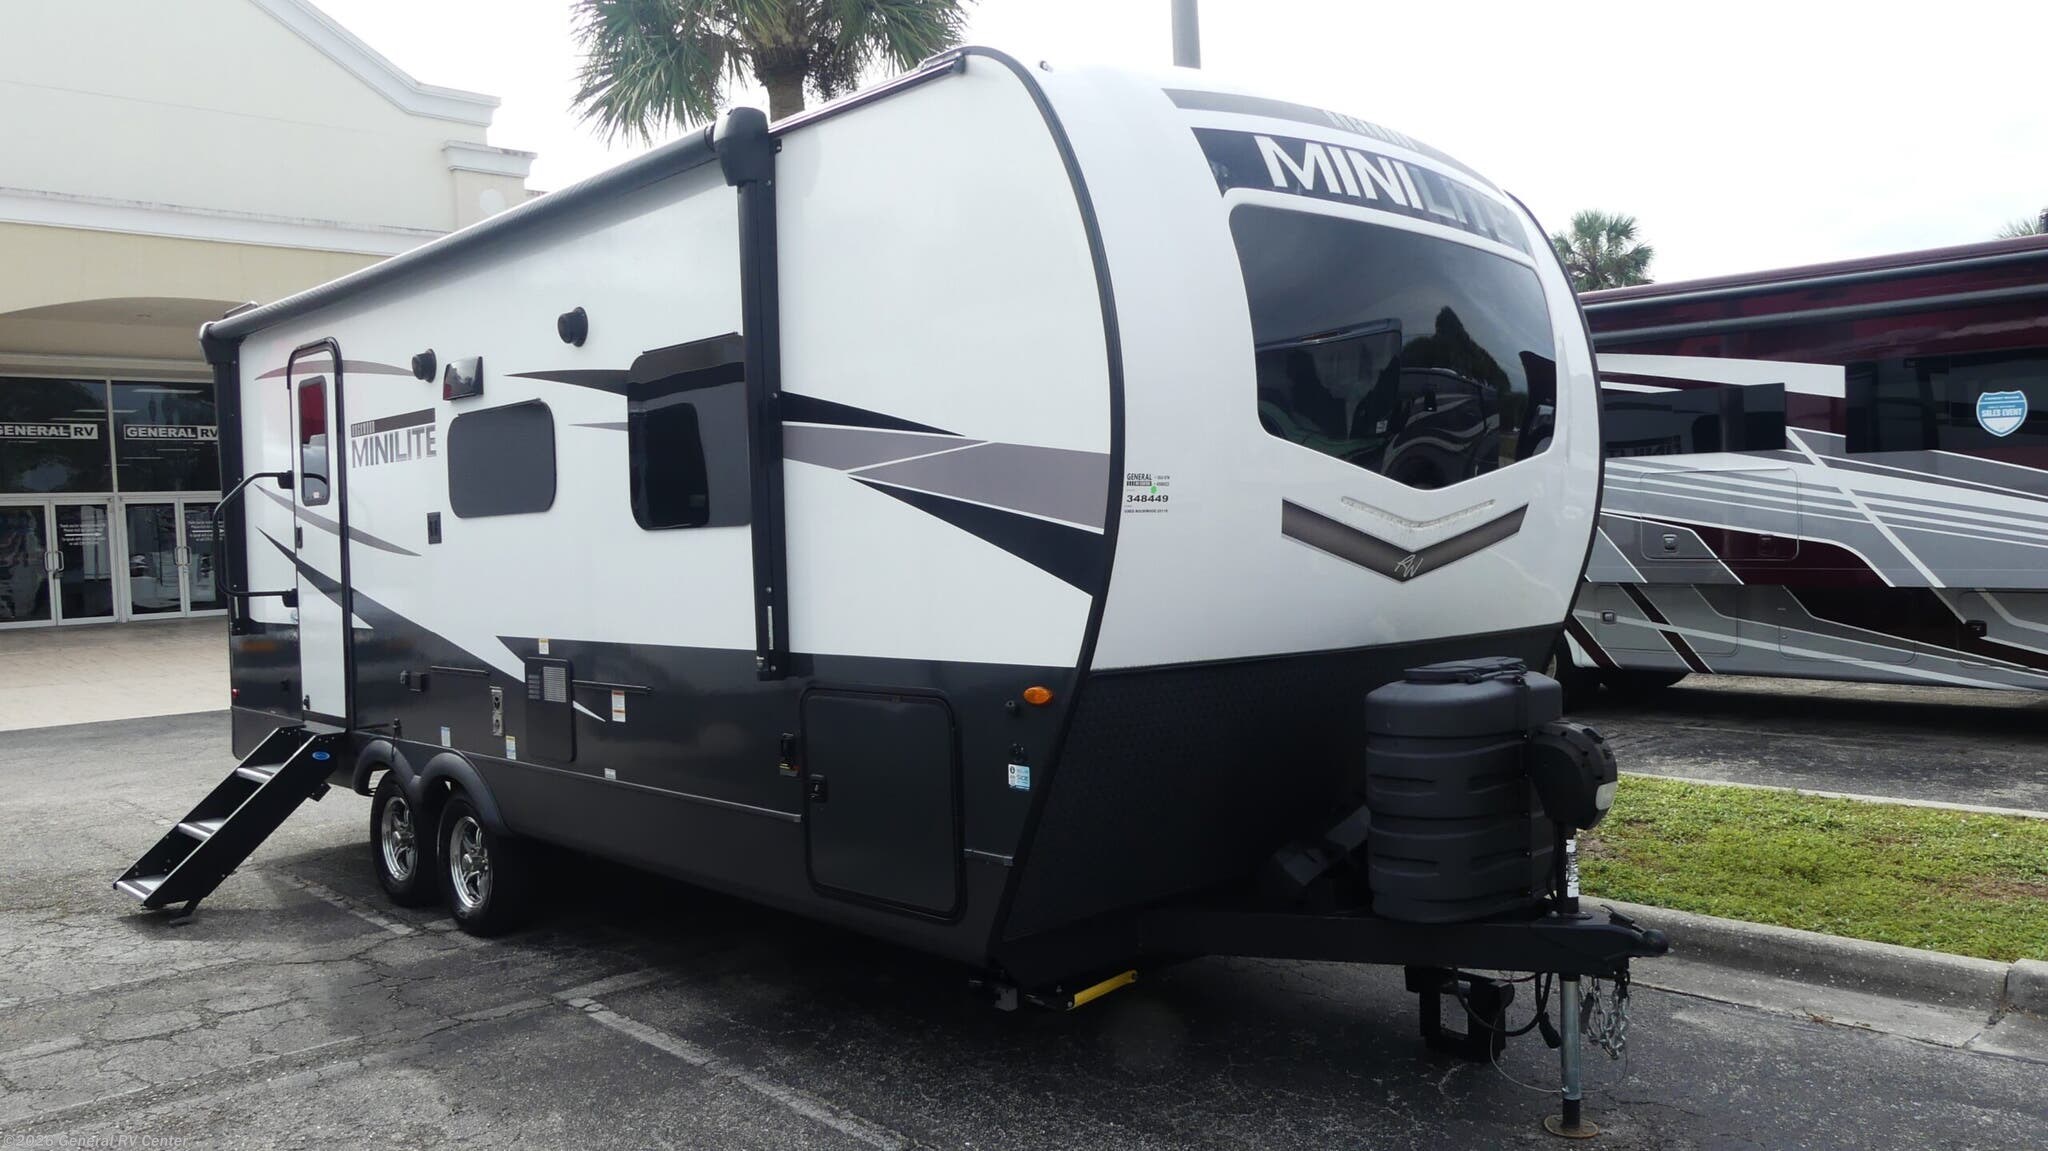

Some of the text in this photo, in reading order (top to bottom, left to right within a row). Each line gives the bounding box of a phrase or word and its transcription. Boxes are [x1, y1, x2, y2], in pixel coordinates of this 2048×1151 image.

[74, 426, 94, 437] RV
[127, 427, 218, 438] GENERAL RV
[351, 424, 437, 468] MINILITE
[1126, 472, 1152, 481] GENERAL
[1126, 494, 1169, 503] 348449
